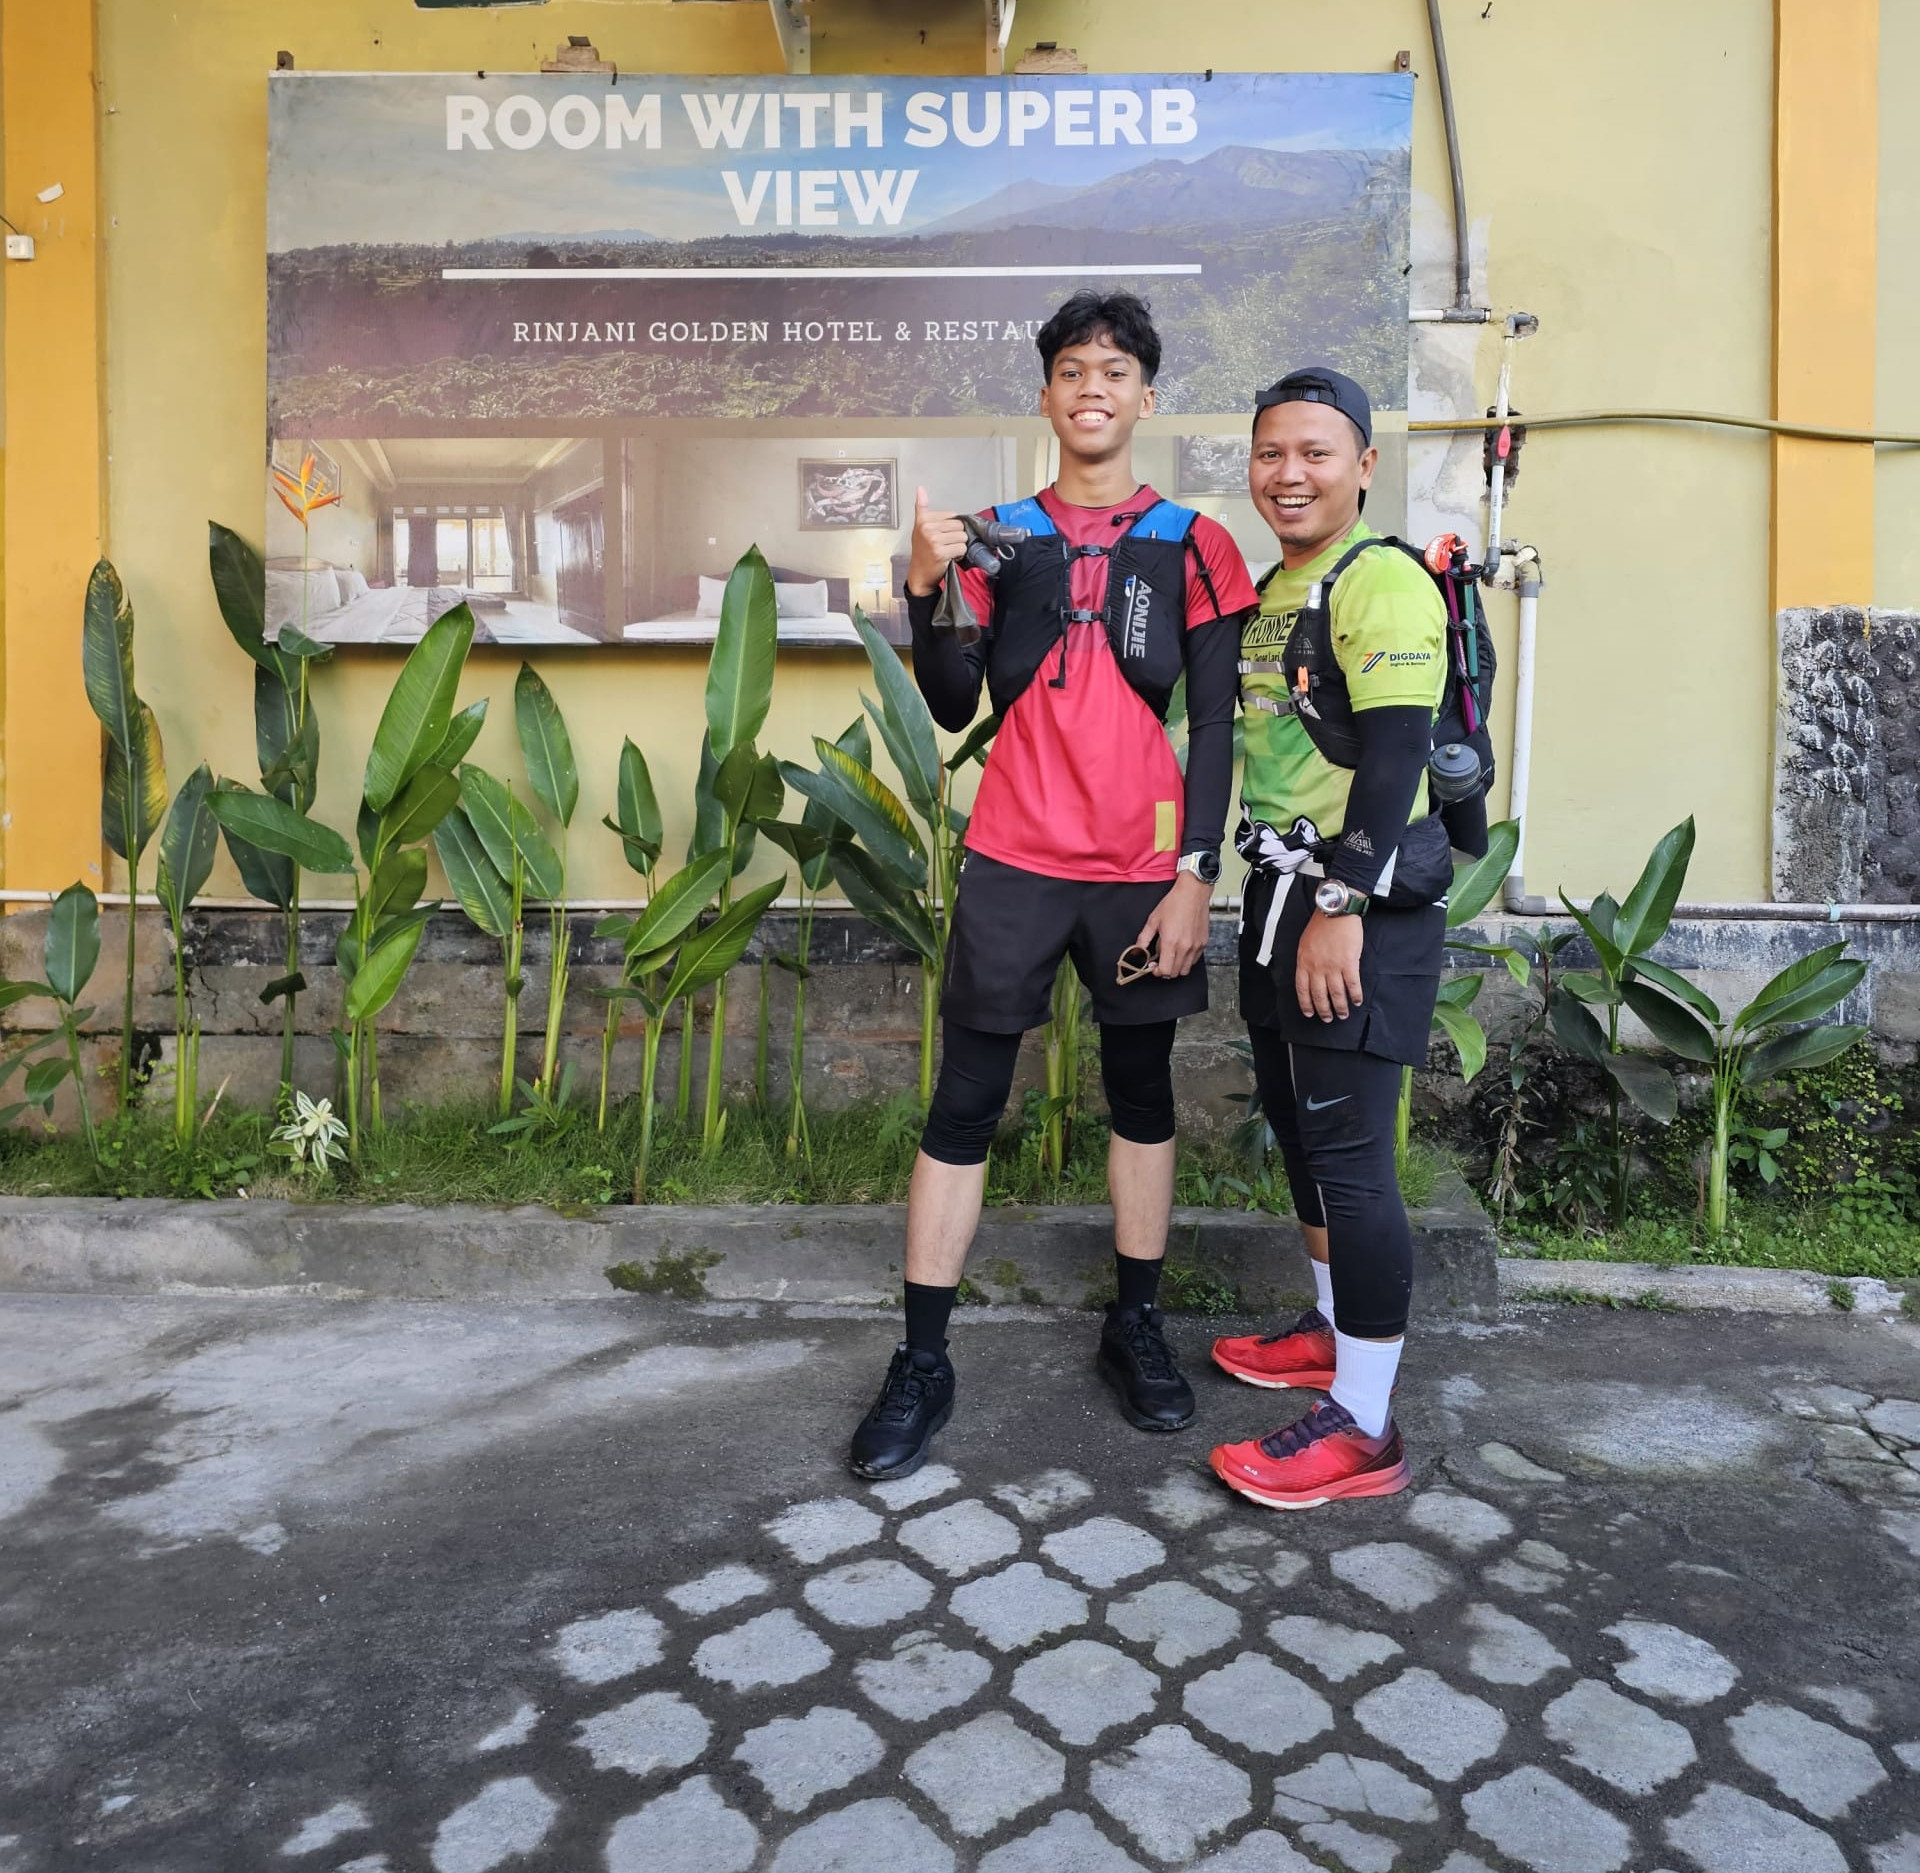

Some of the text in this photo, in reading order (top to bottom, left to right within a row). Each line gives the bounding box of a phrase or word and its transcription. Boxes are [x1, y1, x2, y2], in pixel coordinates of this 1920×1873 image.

[446, 89, 1198, 150] ROOM WITH SUPERB
[721, 169, 919, 227] VIEW
[513, 322, 636, 342] RINJANI
[649, 322, 769, 342] GOLDEN
[783, 321, 882, 342] HOTEL
[895, 321, 911, 341] &
[1129, 579, 1153, 659] AONIJIE
[1389, 652, 1431, 662] DIGDAYA
